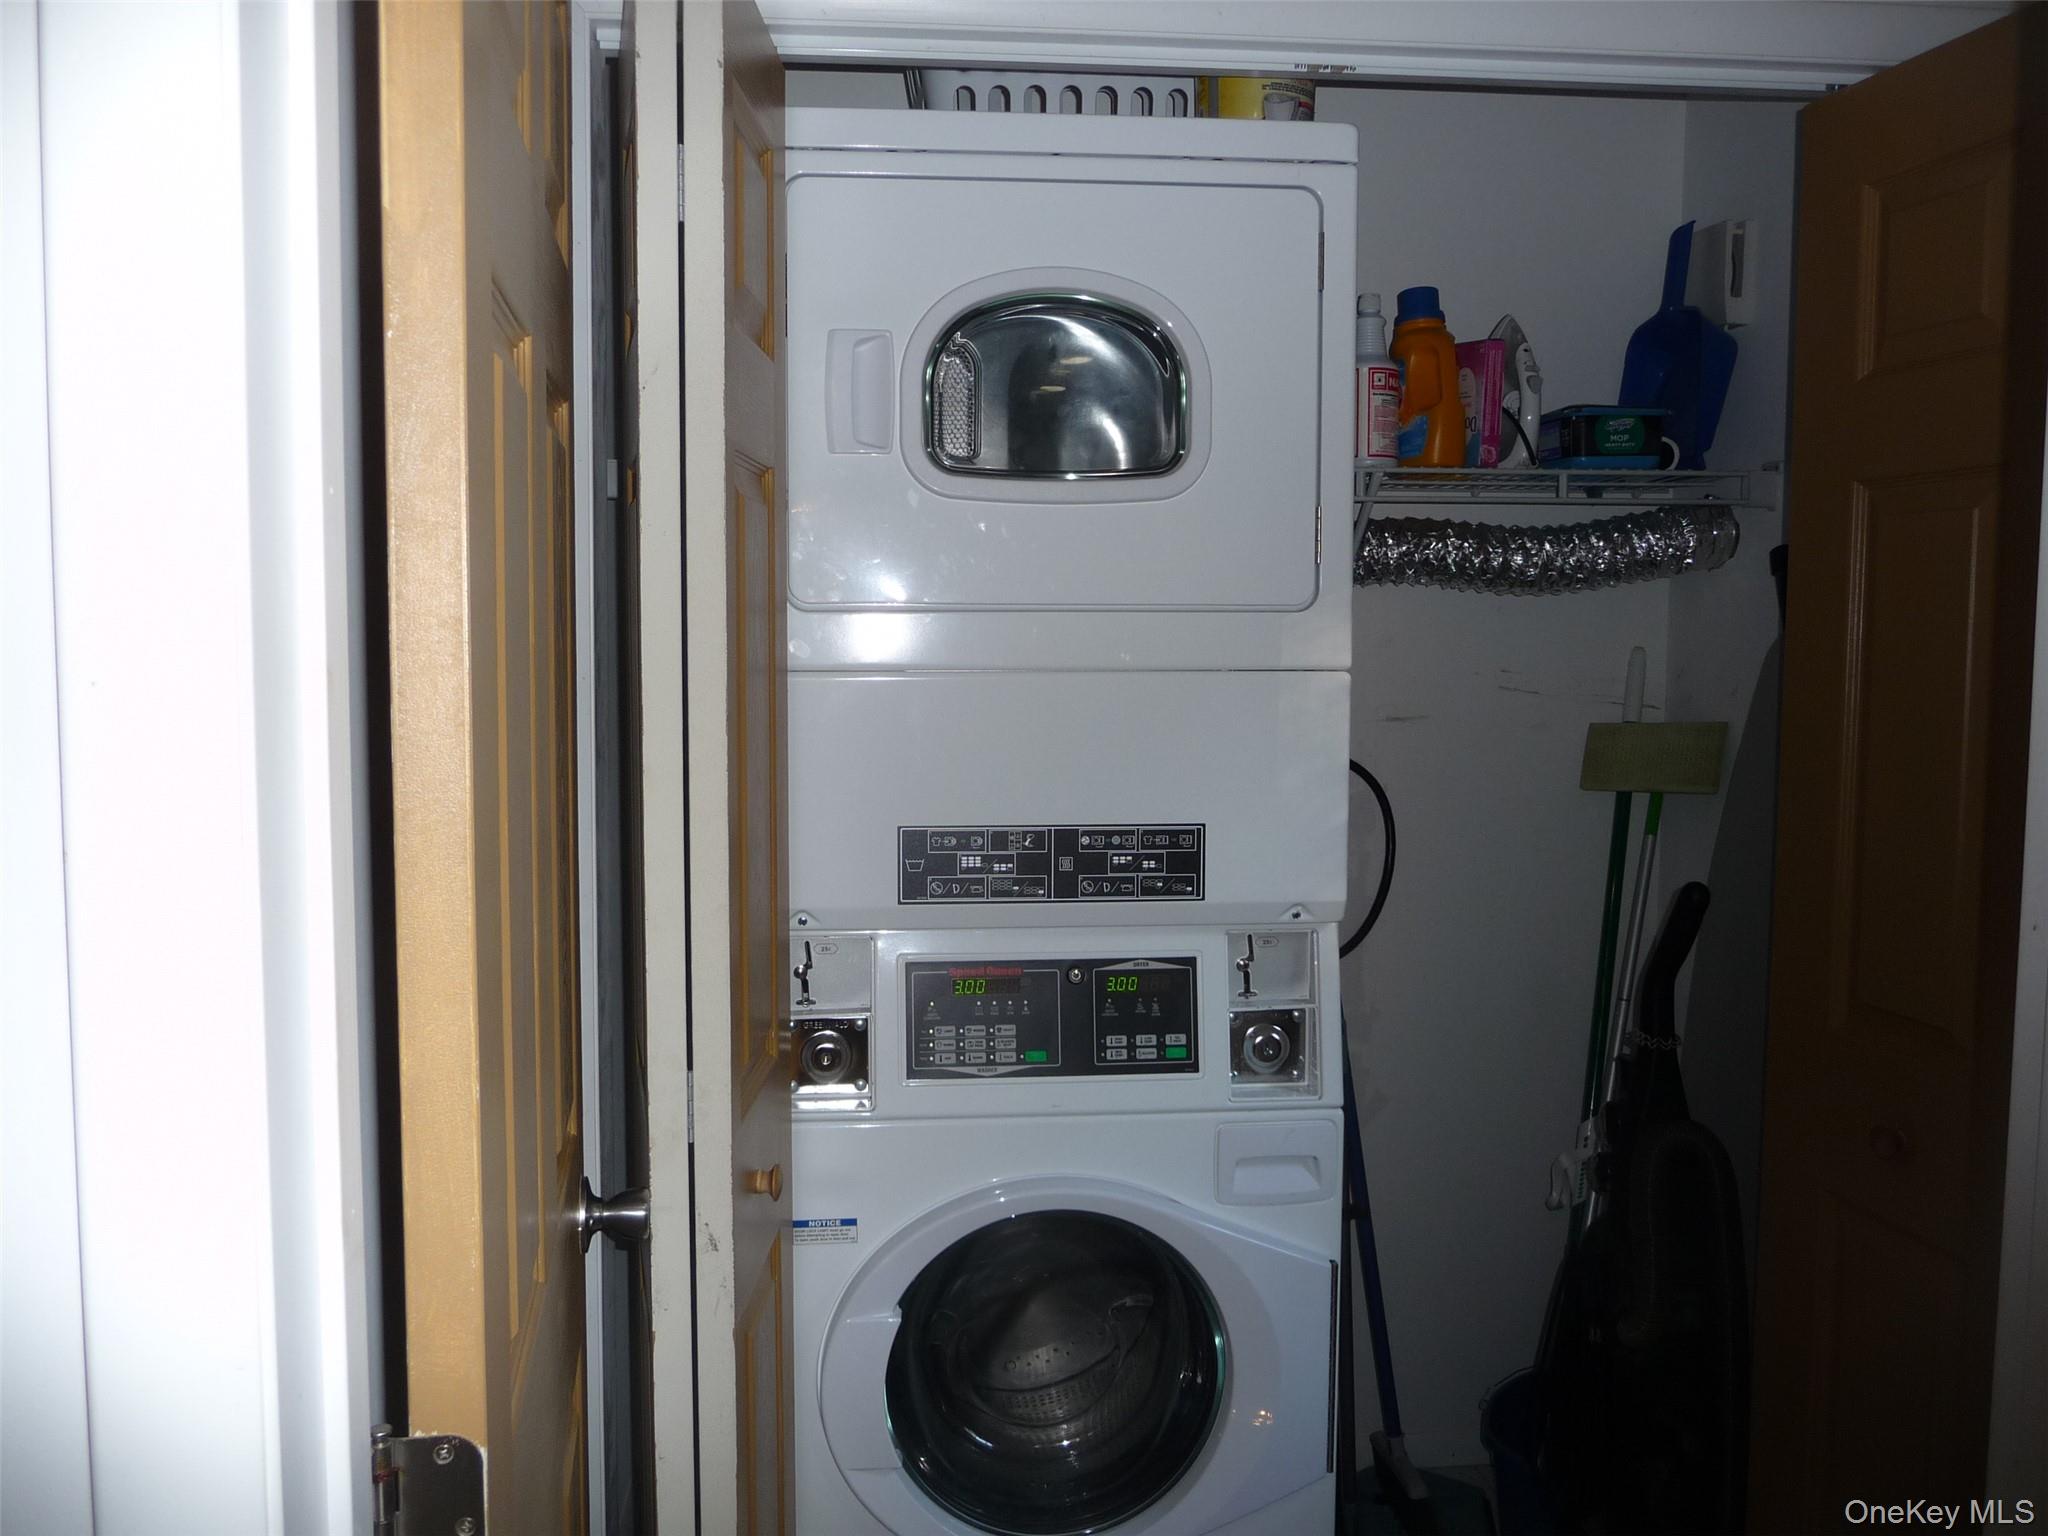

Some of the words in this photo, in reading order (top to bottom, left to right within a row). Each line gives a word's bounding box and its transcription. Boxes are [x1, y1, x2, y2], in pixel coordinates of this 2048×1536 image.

[1610, 434, 1630, 442] MOP
[1106, 976, 1138, 992] 3.00
[808, 1219, 841, 1227] NOTICE
